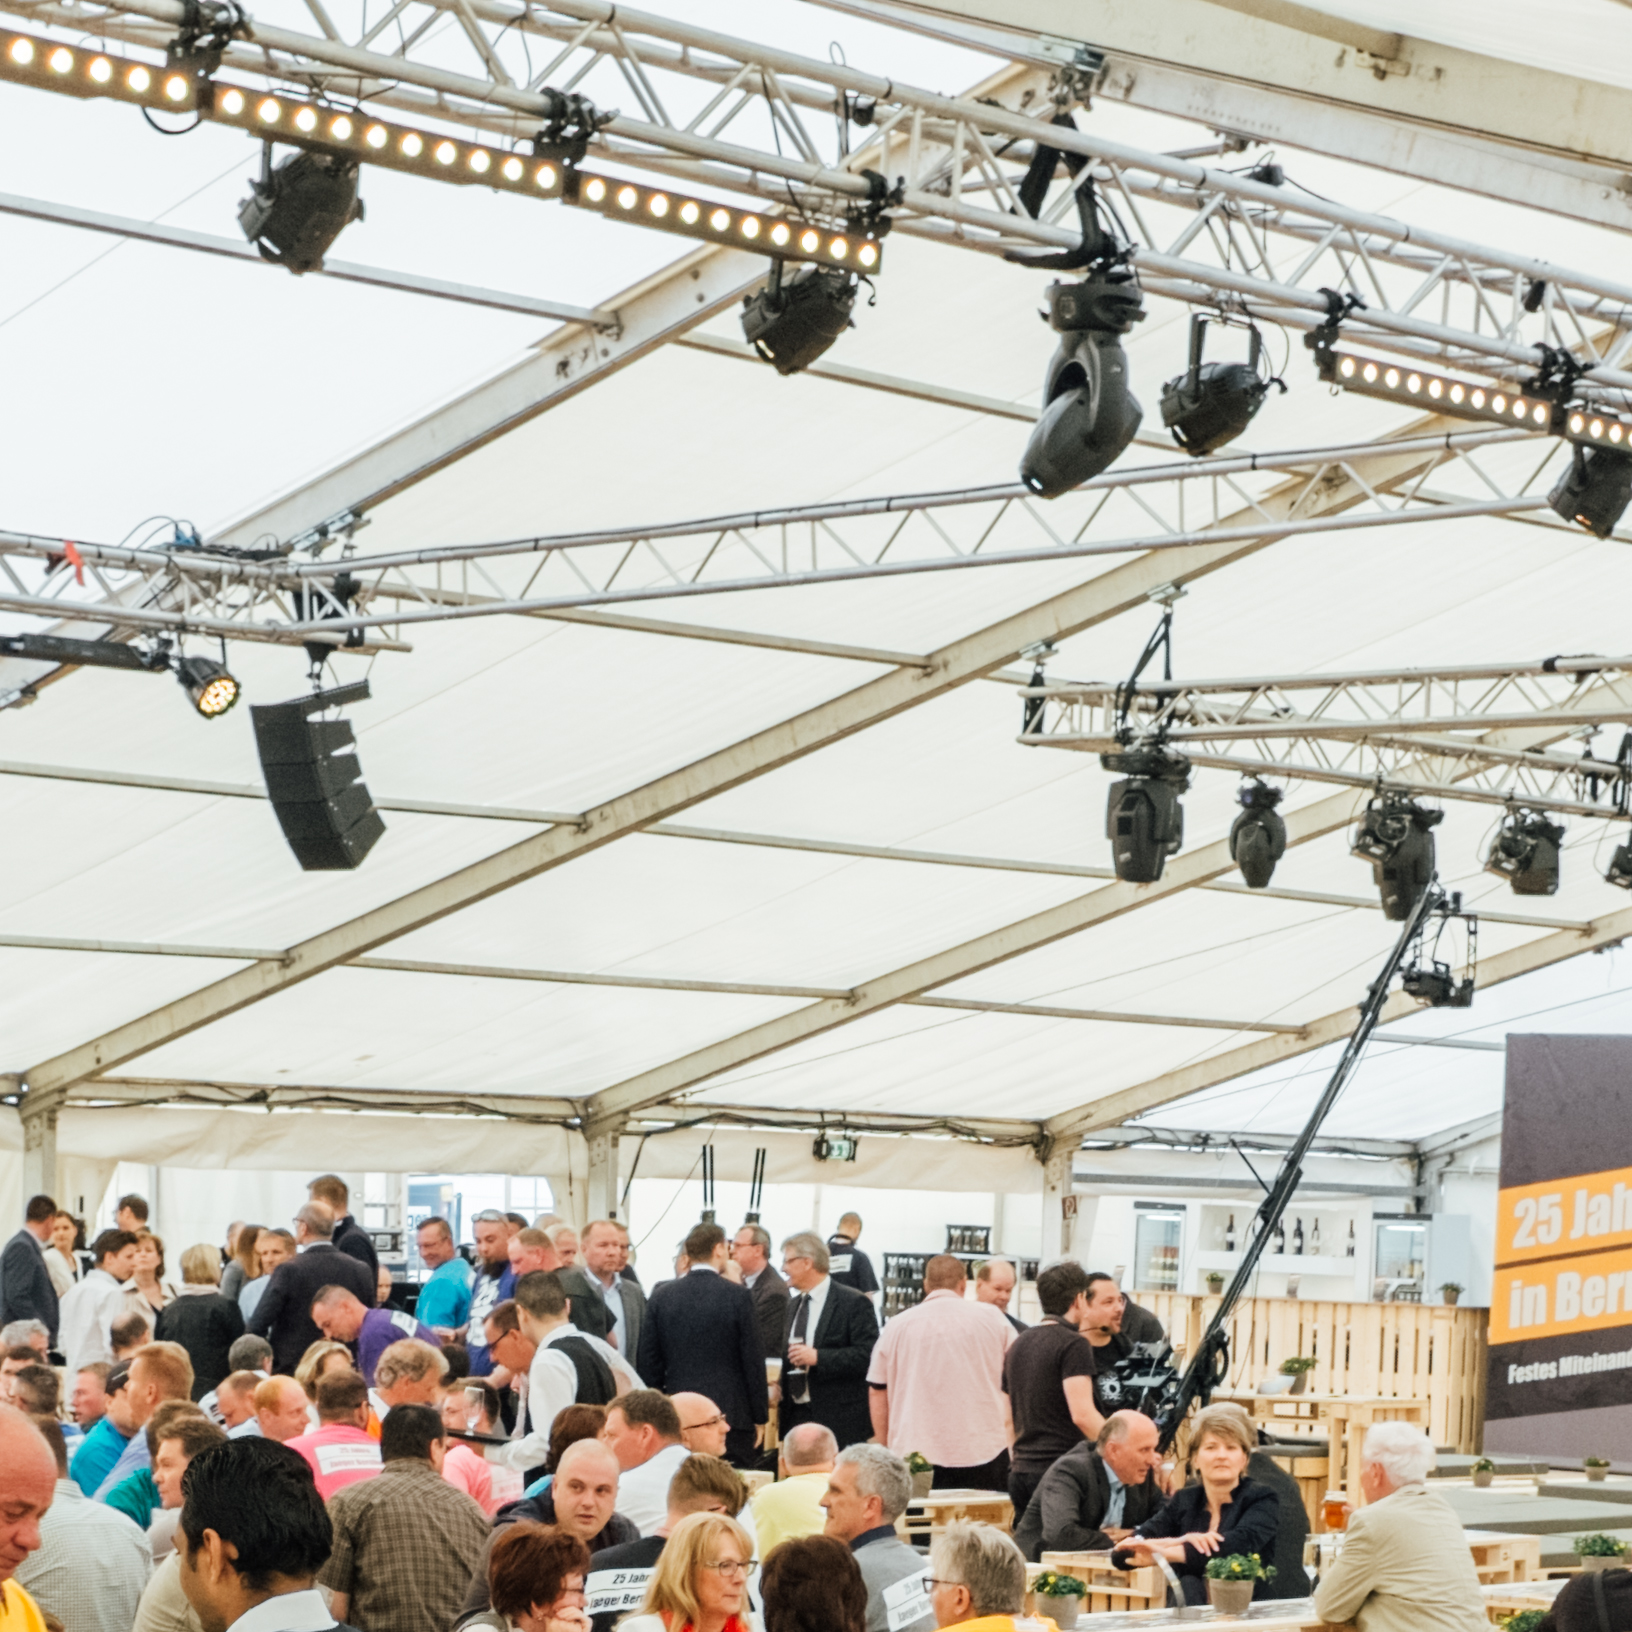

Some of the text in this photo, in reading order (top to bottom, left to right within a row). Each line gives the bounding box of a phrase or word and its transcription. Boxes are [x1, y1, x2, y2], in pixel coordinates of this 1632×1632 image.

[1512, 1193, 1563, 1249] 25
[1509, 1280, 1547, 1330] in
[1508, 1363, 1557, 1384] Festes
[613, 1574, 626, 1584] 25
